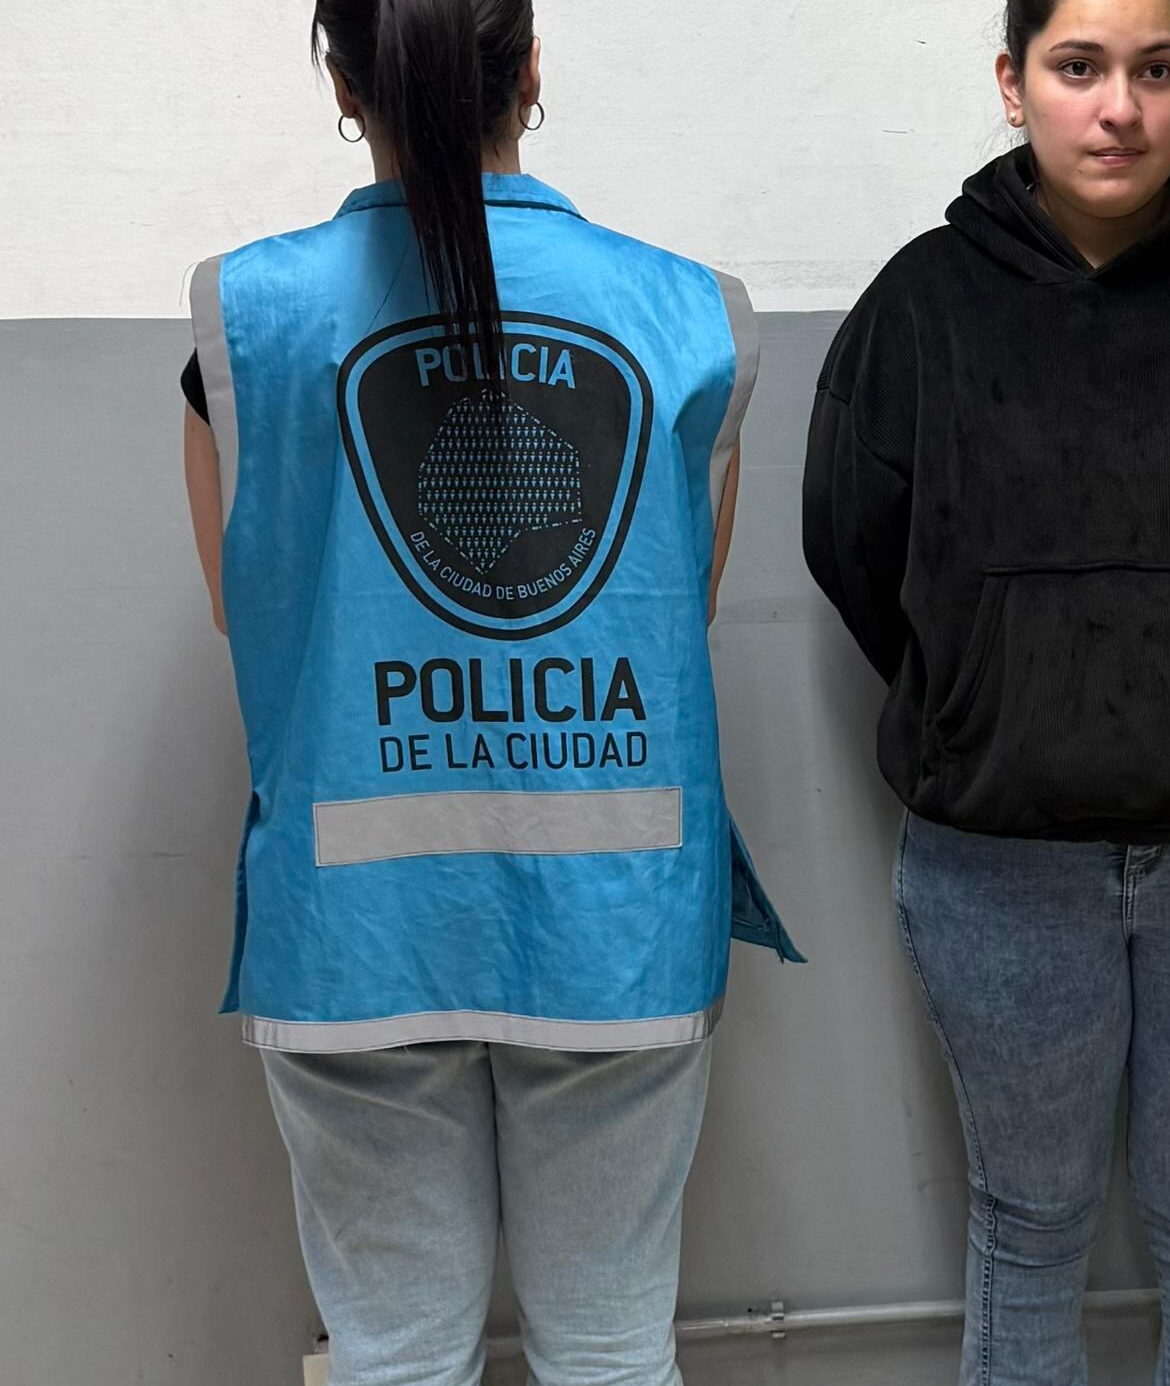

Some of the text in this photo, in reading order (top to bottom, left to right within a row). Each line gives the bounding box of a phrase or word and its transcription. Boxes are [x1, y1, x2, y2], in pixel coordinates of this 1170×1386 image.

[411, 527, 596, 600] DE LA CIUDAD DE BUENOS AIRES
[374, 657, 647, 726] POLICIA
[379, 731, 648, 773] DE LA CIUDAD
